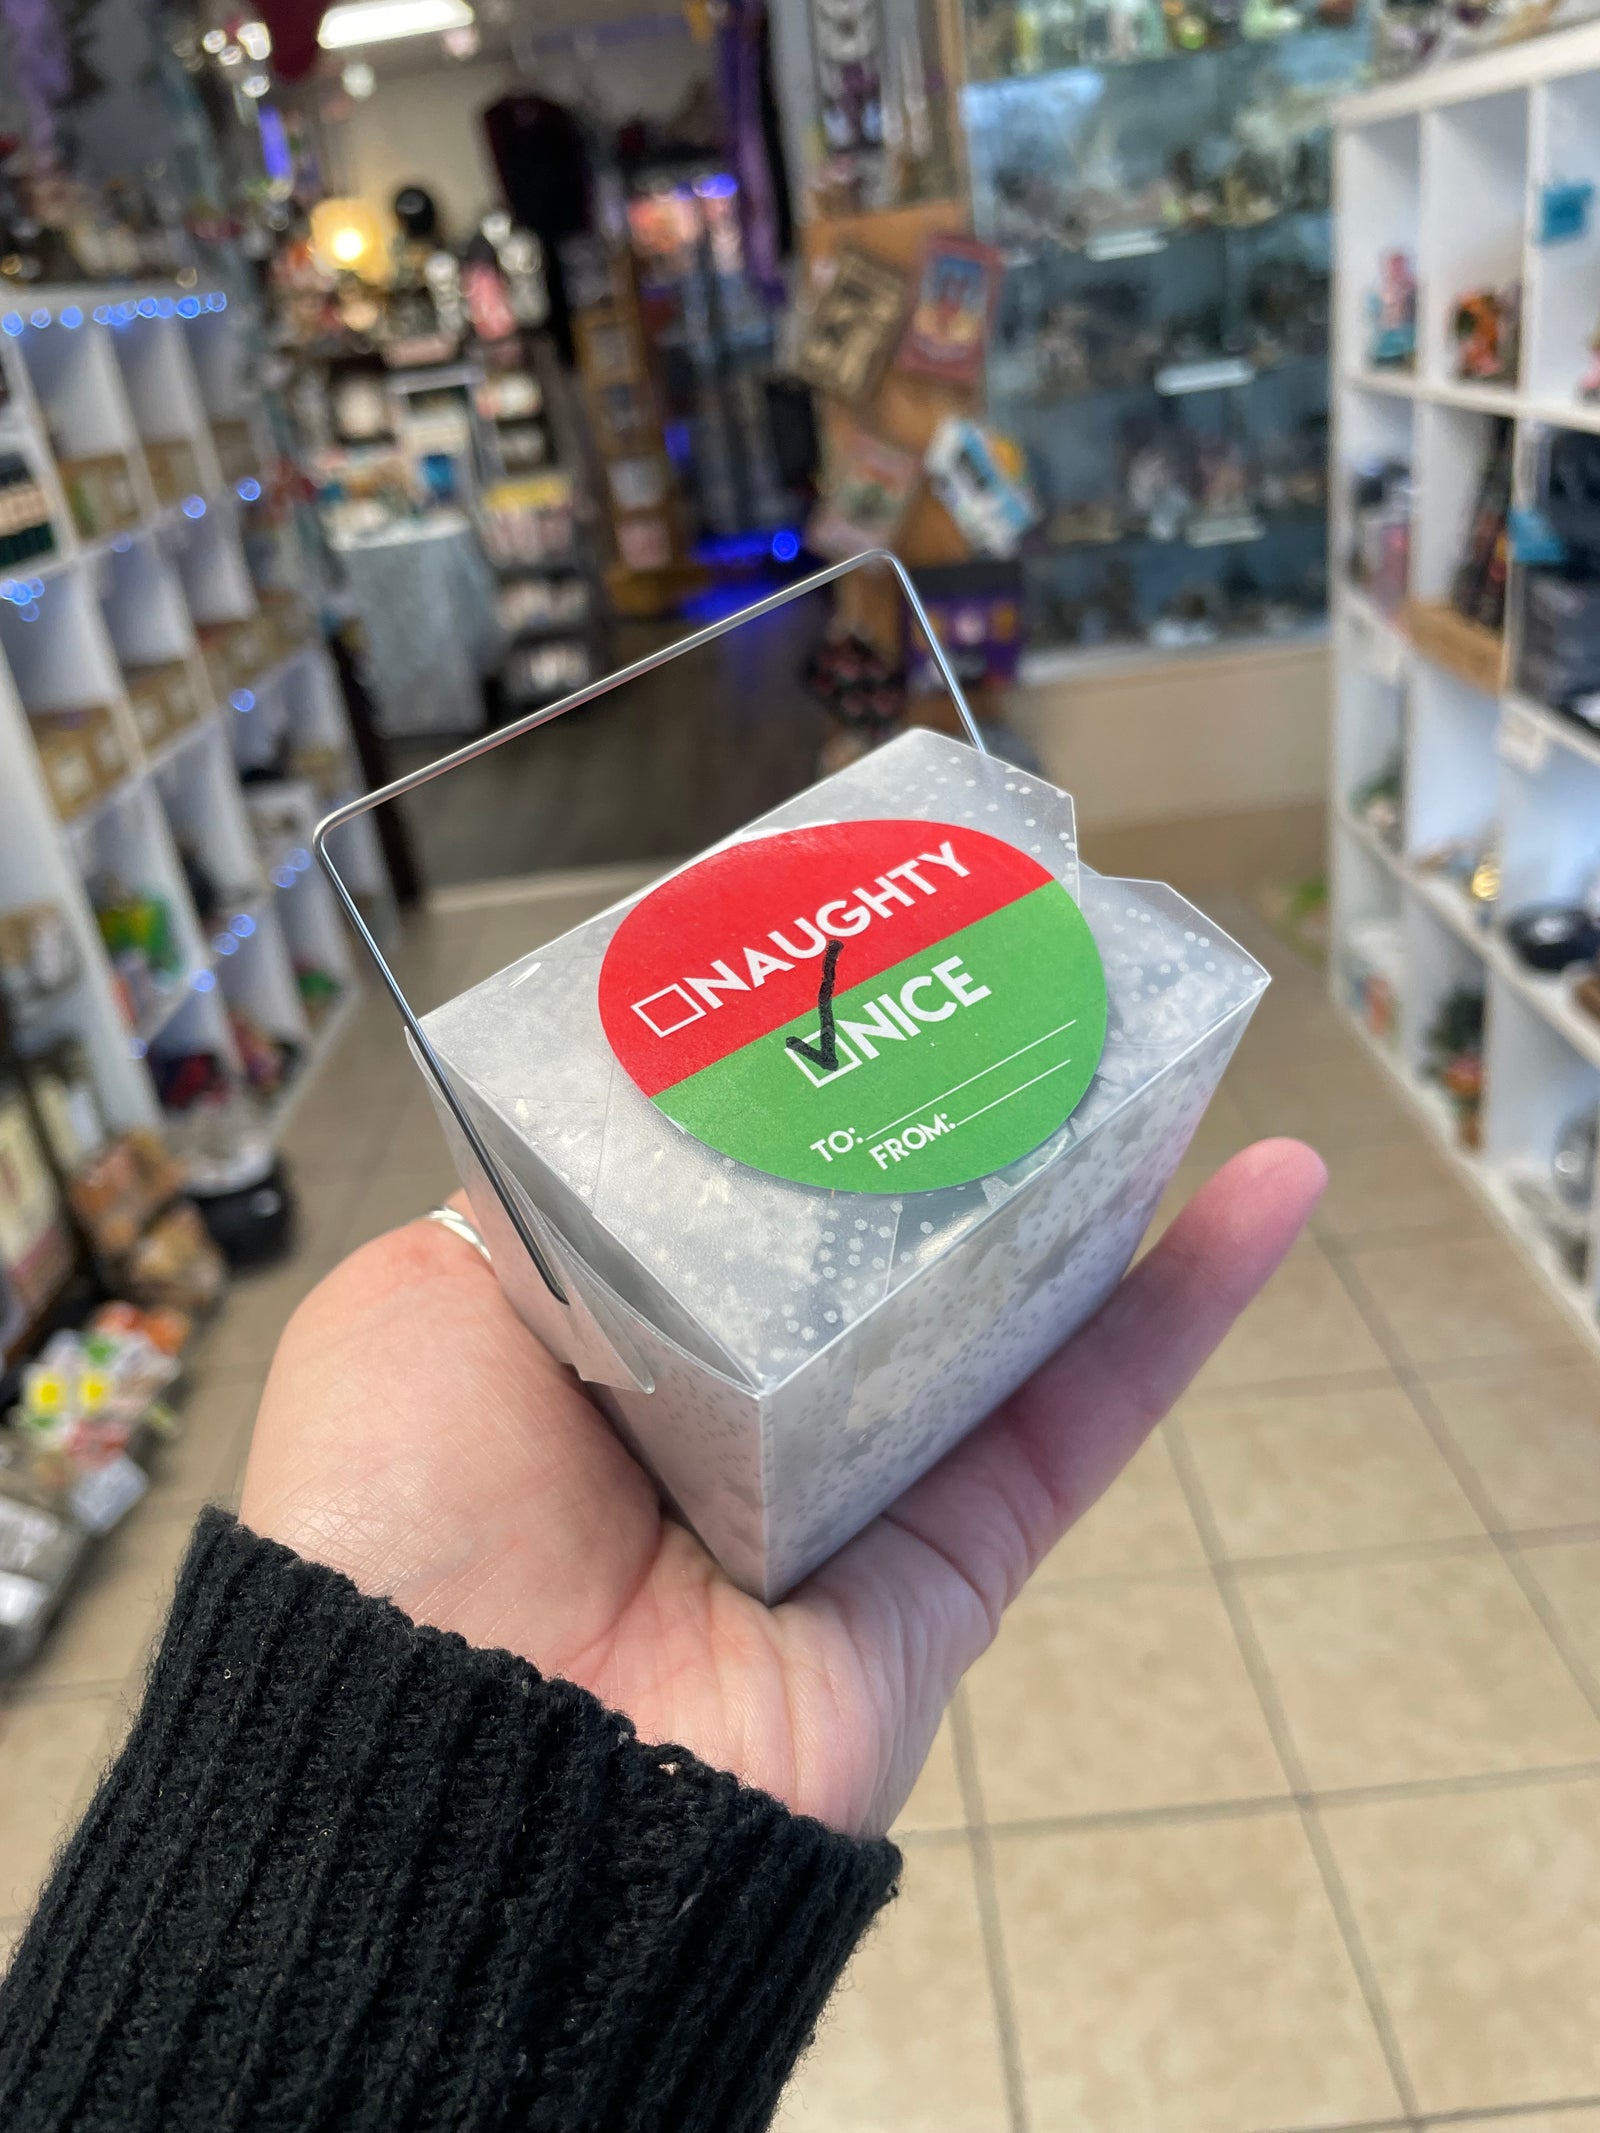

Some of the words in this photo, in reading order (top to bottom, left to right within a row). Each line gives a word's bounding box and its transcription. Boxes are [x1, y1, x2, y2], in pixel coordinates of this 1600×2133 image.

[683, 841, 971, 1010] NAUGHTY
[836, 955, 992, 1060] NICE
[810, 1126, 865, 1163] TO:
[869, 1112, 957, 1170] FROM:
